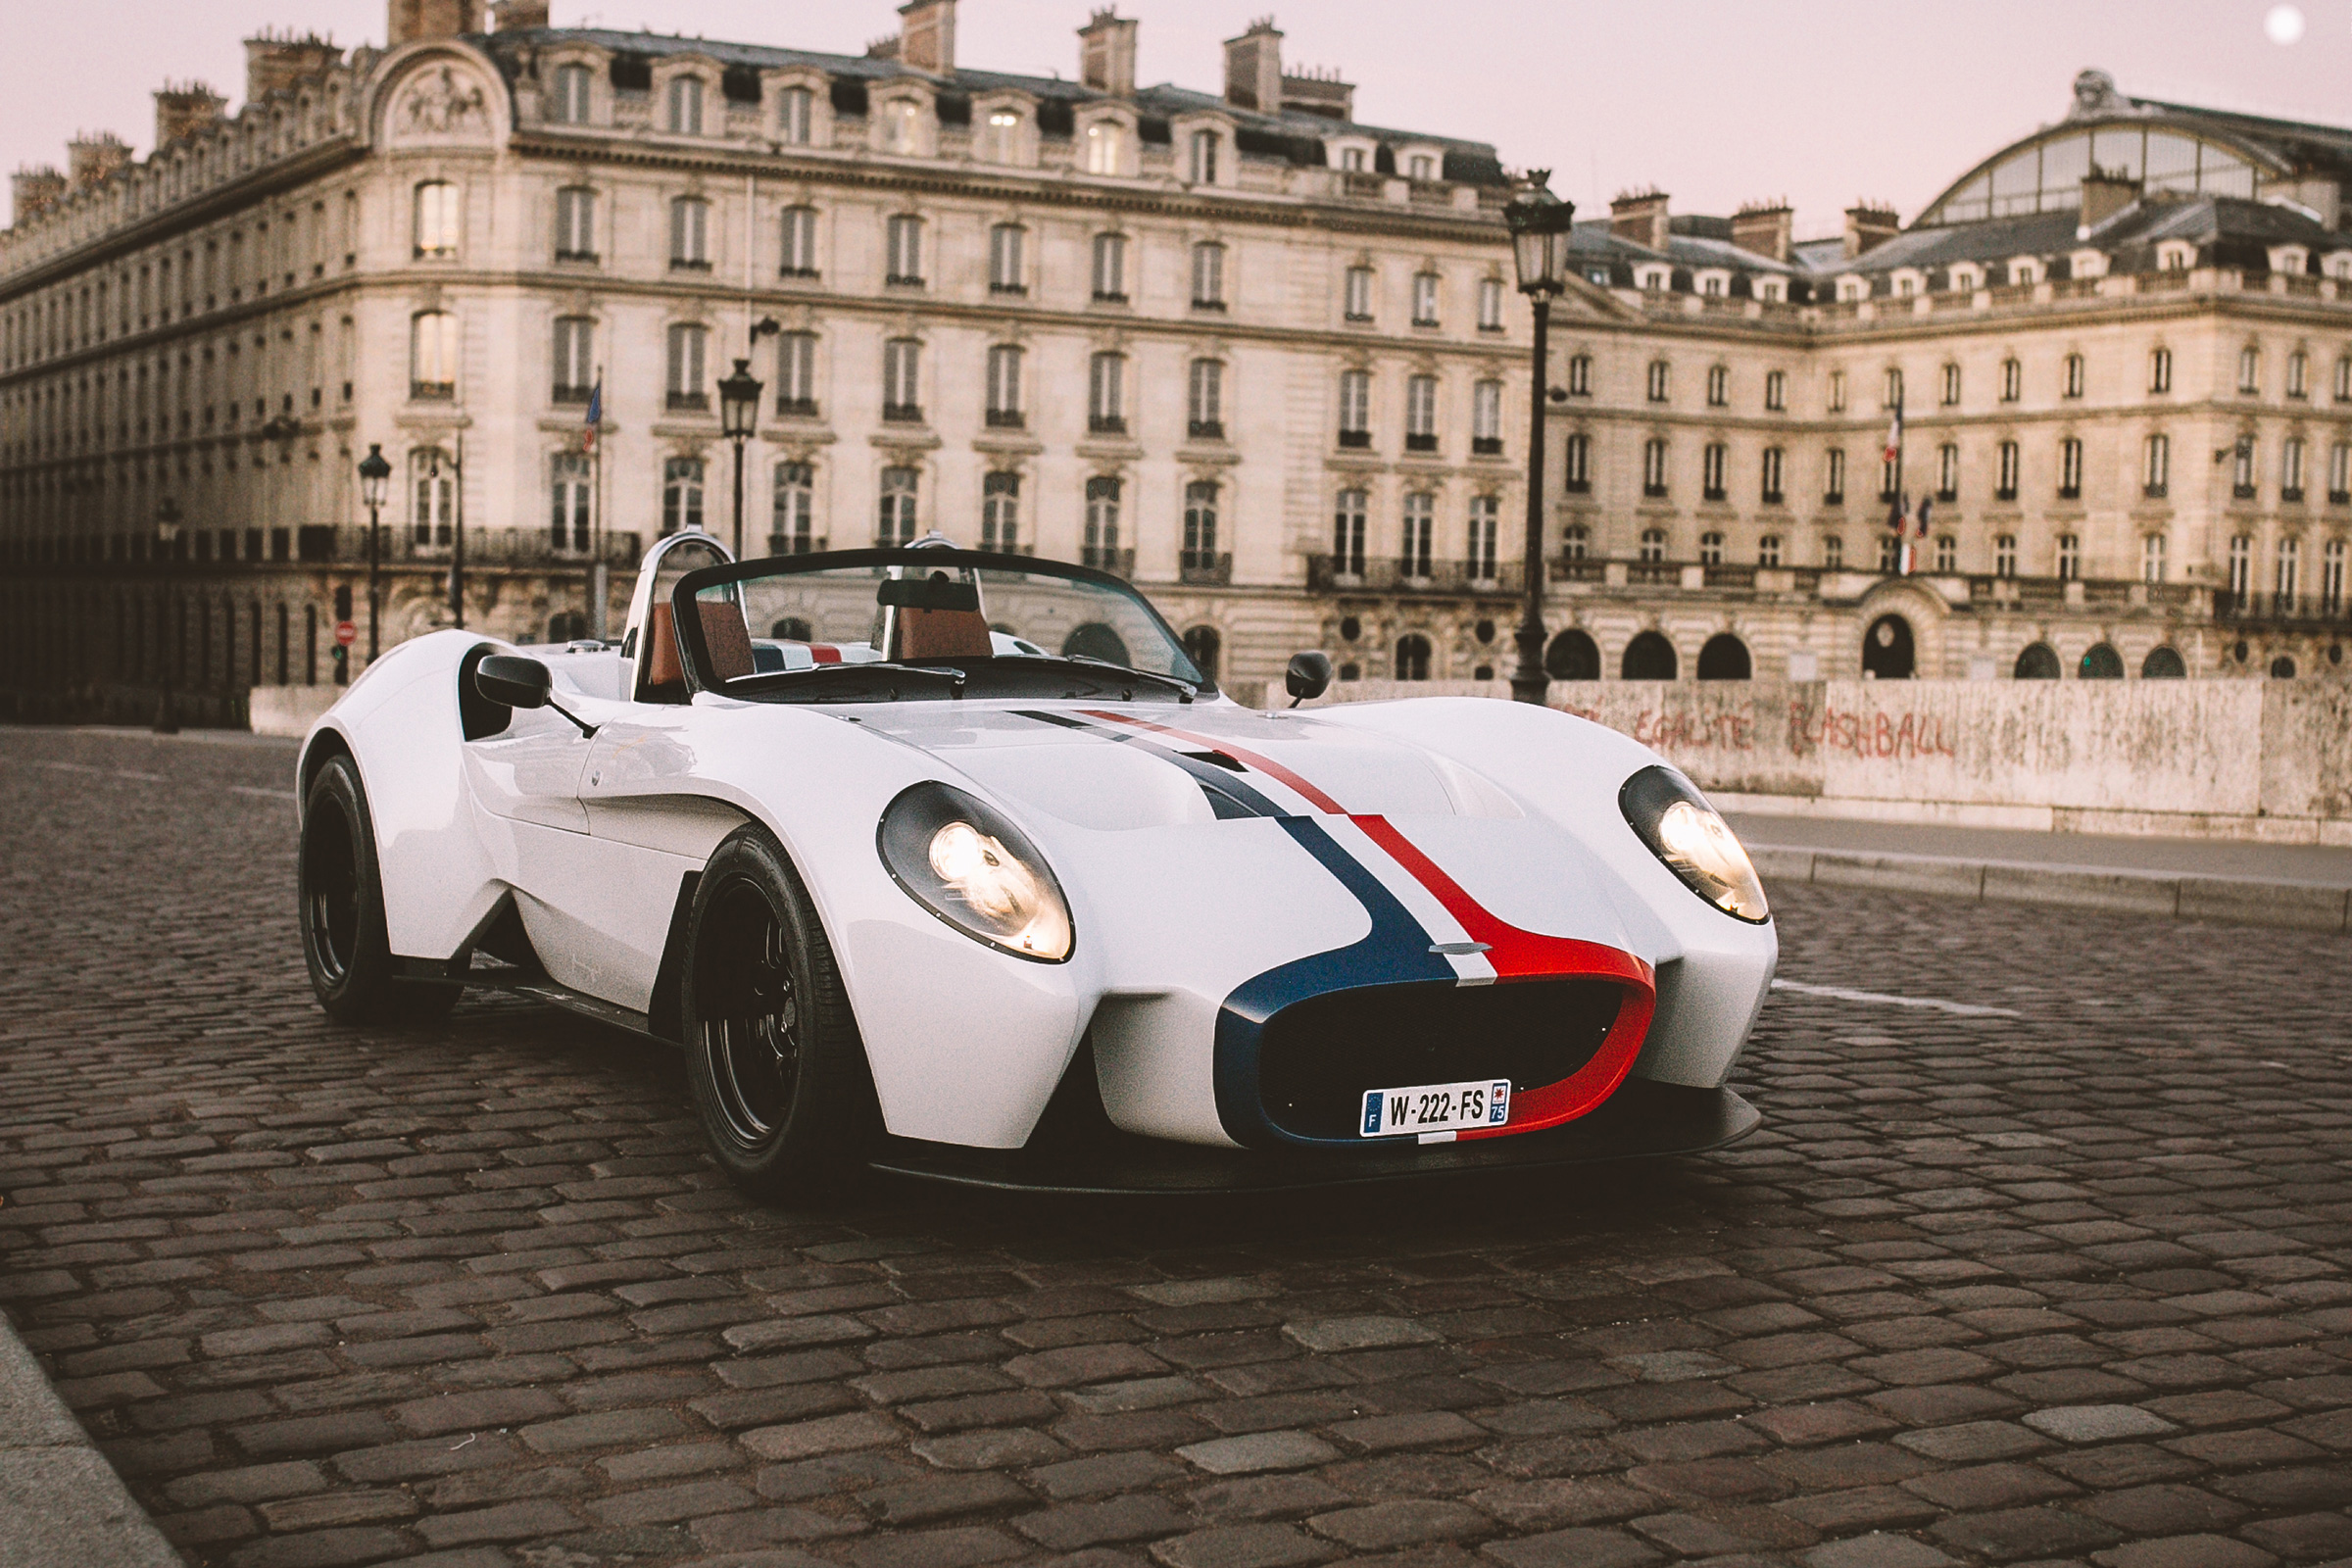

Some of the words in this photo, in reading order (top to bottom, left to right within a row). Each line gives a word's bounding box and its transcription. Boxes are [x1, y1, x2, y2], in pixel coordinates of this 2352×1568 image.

[1790, 702, 1954, 759] FLASHBALL
[1368, 1113, 1377, 1127] F
[1391, 1090, 1484, 1126] W-222-FS
[1491, 1105, 1504, 1119] 75
